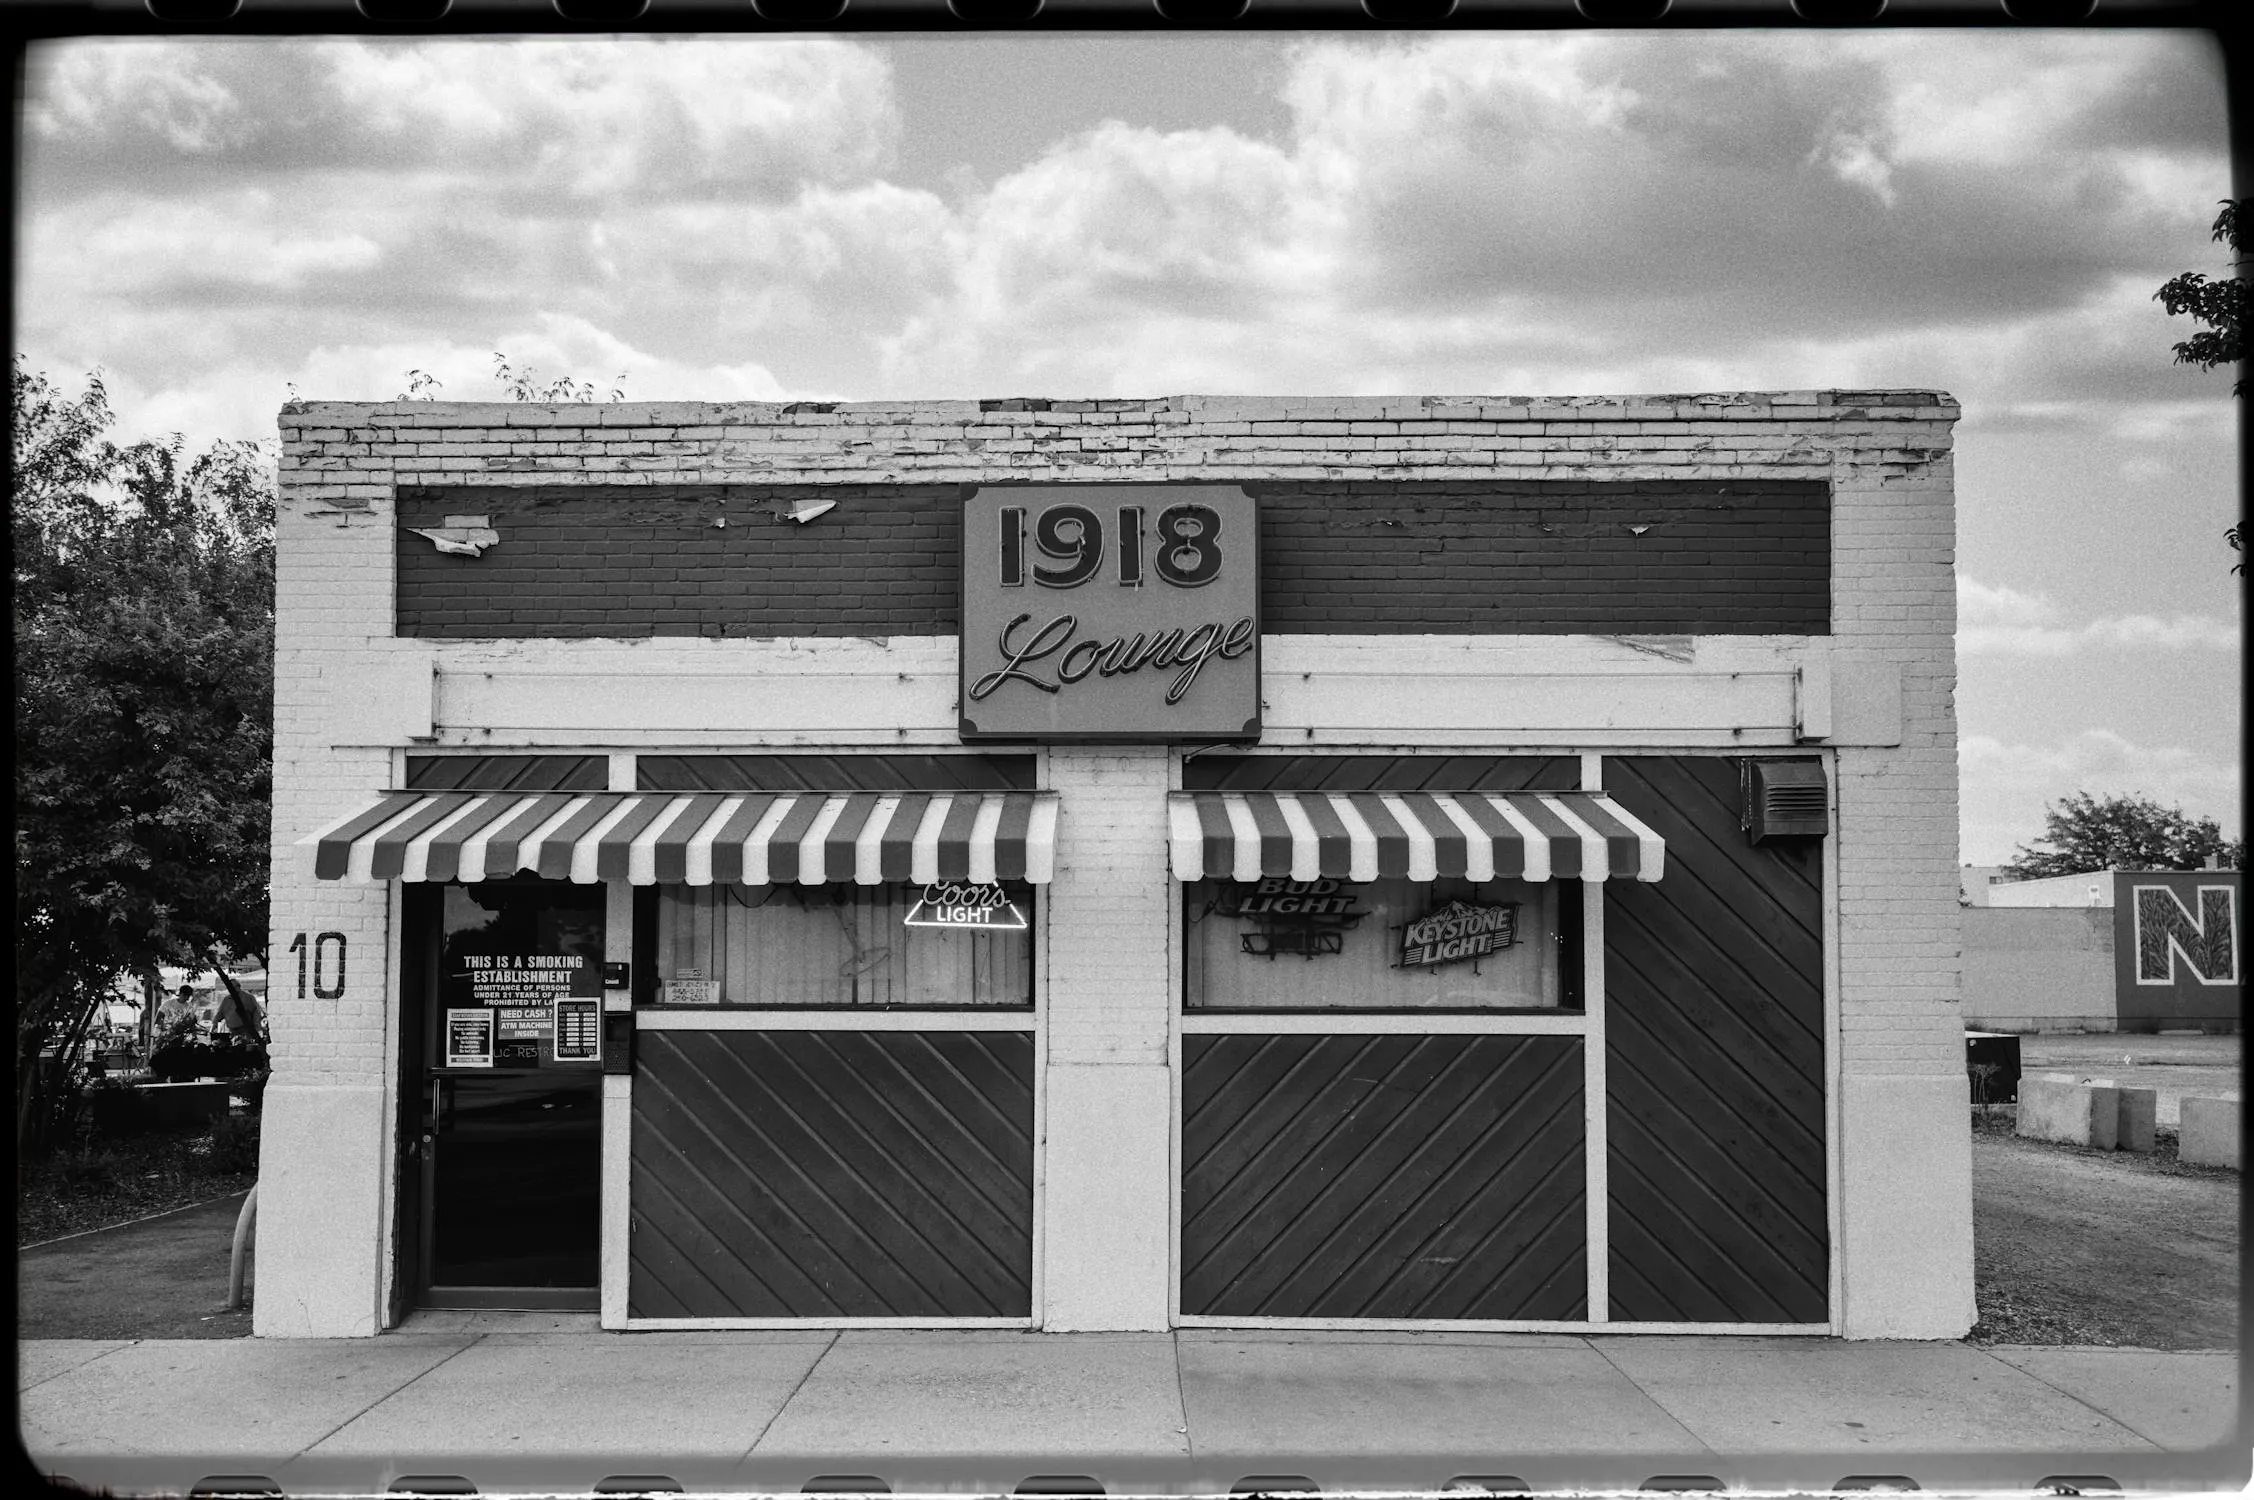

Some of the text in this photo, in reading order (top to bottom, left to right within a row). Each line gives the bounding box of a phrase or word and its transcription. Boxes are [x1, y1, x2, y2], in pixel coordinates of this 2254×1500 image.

[1000, 503, 1225, 588] 1918
[969, 614, 1254, 705] Lounge
[923, 881, 1010, 908] Coors
[1257, 878, 1340, 895] BUD
[1239, 897, 1356, 913] LIGHT
[936, 906, 993, 923] LIGHT
[1404, 904, 1511, 948] KEYSTONE
[2133, 885, 2239, 985] N
[1421, 934, 1491, 963] LIGHT
[288, 932, 347, 999] 10
[463, 955, 584, 969] THIS IS A SMOKING
[473, 970, 573, 984] ESTABLISHMENT
[474, 991, 570, 999] UNDER 21 YEARS OF AGE
[500, 1009, 523, 1018] NEED
[524, 1009, 546, 1018] CASH
[559, 1004, 596, 1012] STORE HOURS
[559, 1047, 596, 1055] THANK YOU
